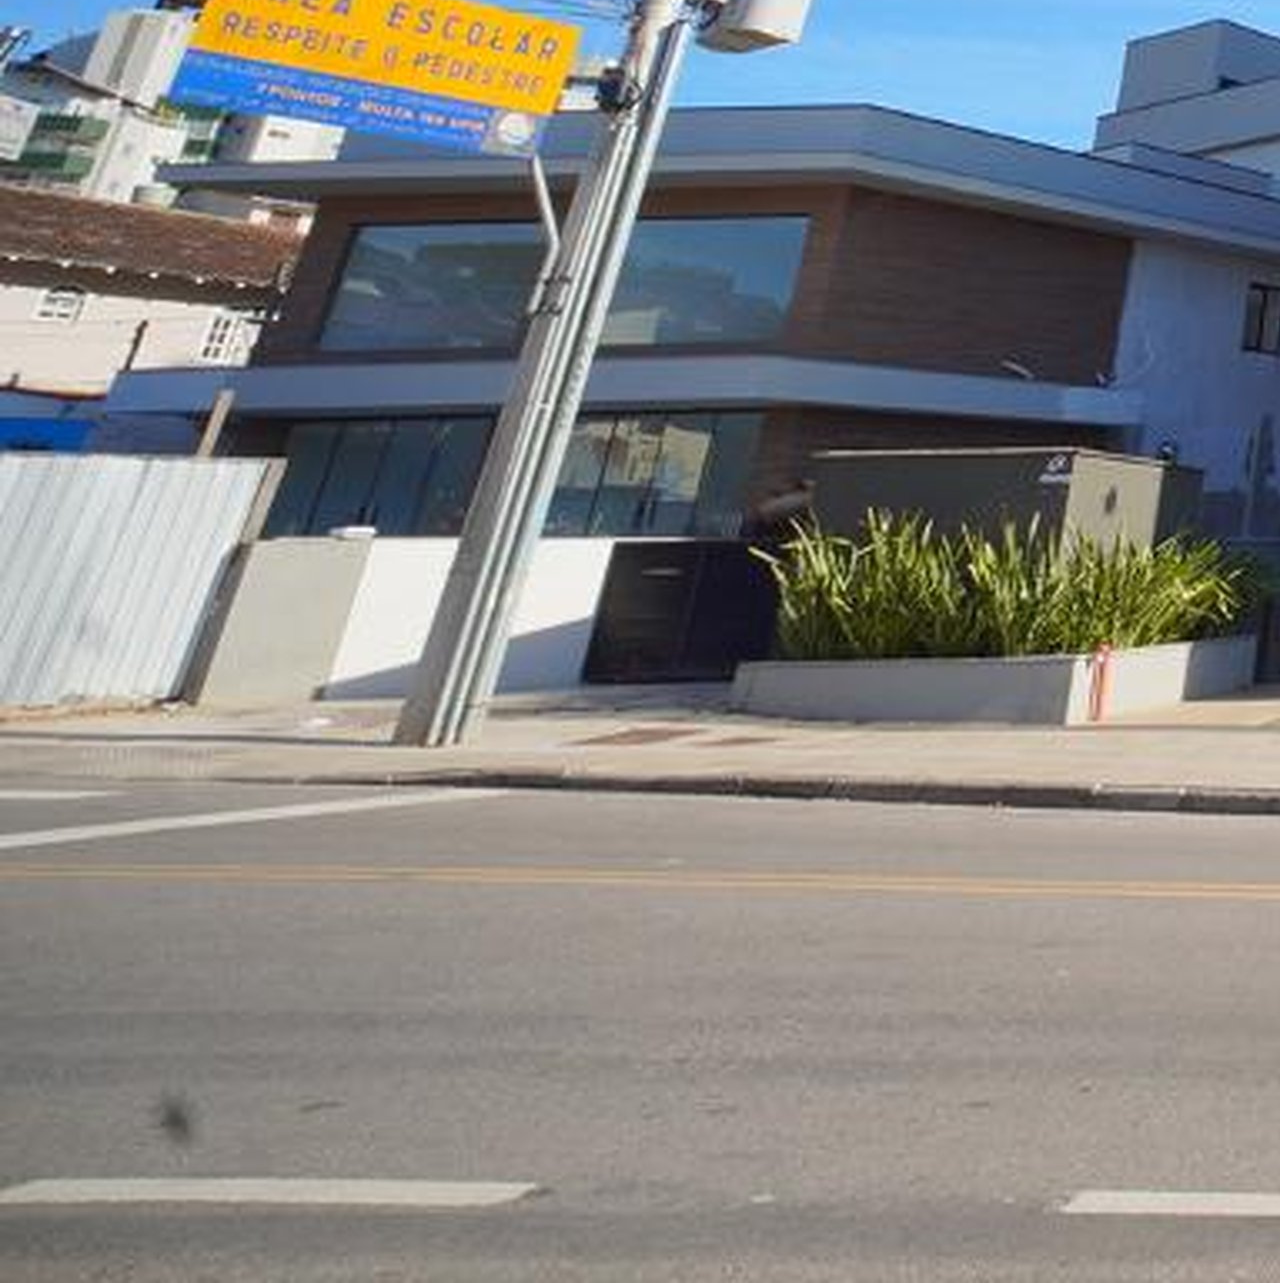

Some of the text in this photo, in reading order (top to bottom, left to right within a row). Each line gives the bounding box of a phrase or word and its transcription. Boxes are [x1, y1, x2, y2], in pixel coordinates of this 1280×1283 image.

[222, 12, 368, 60] RESPEITE
[412, 53, 546, 96] PEDESTRE
[387, 2, 560, 61] ESCOLAR
